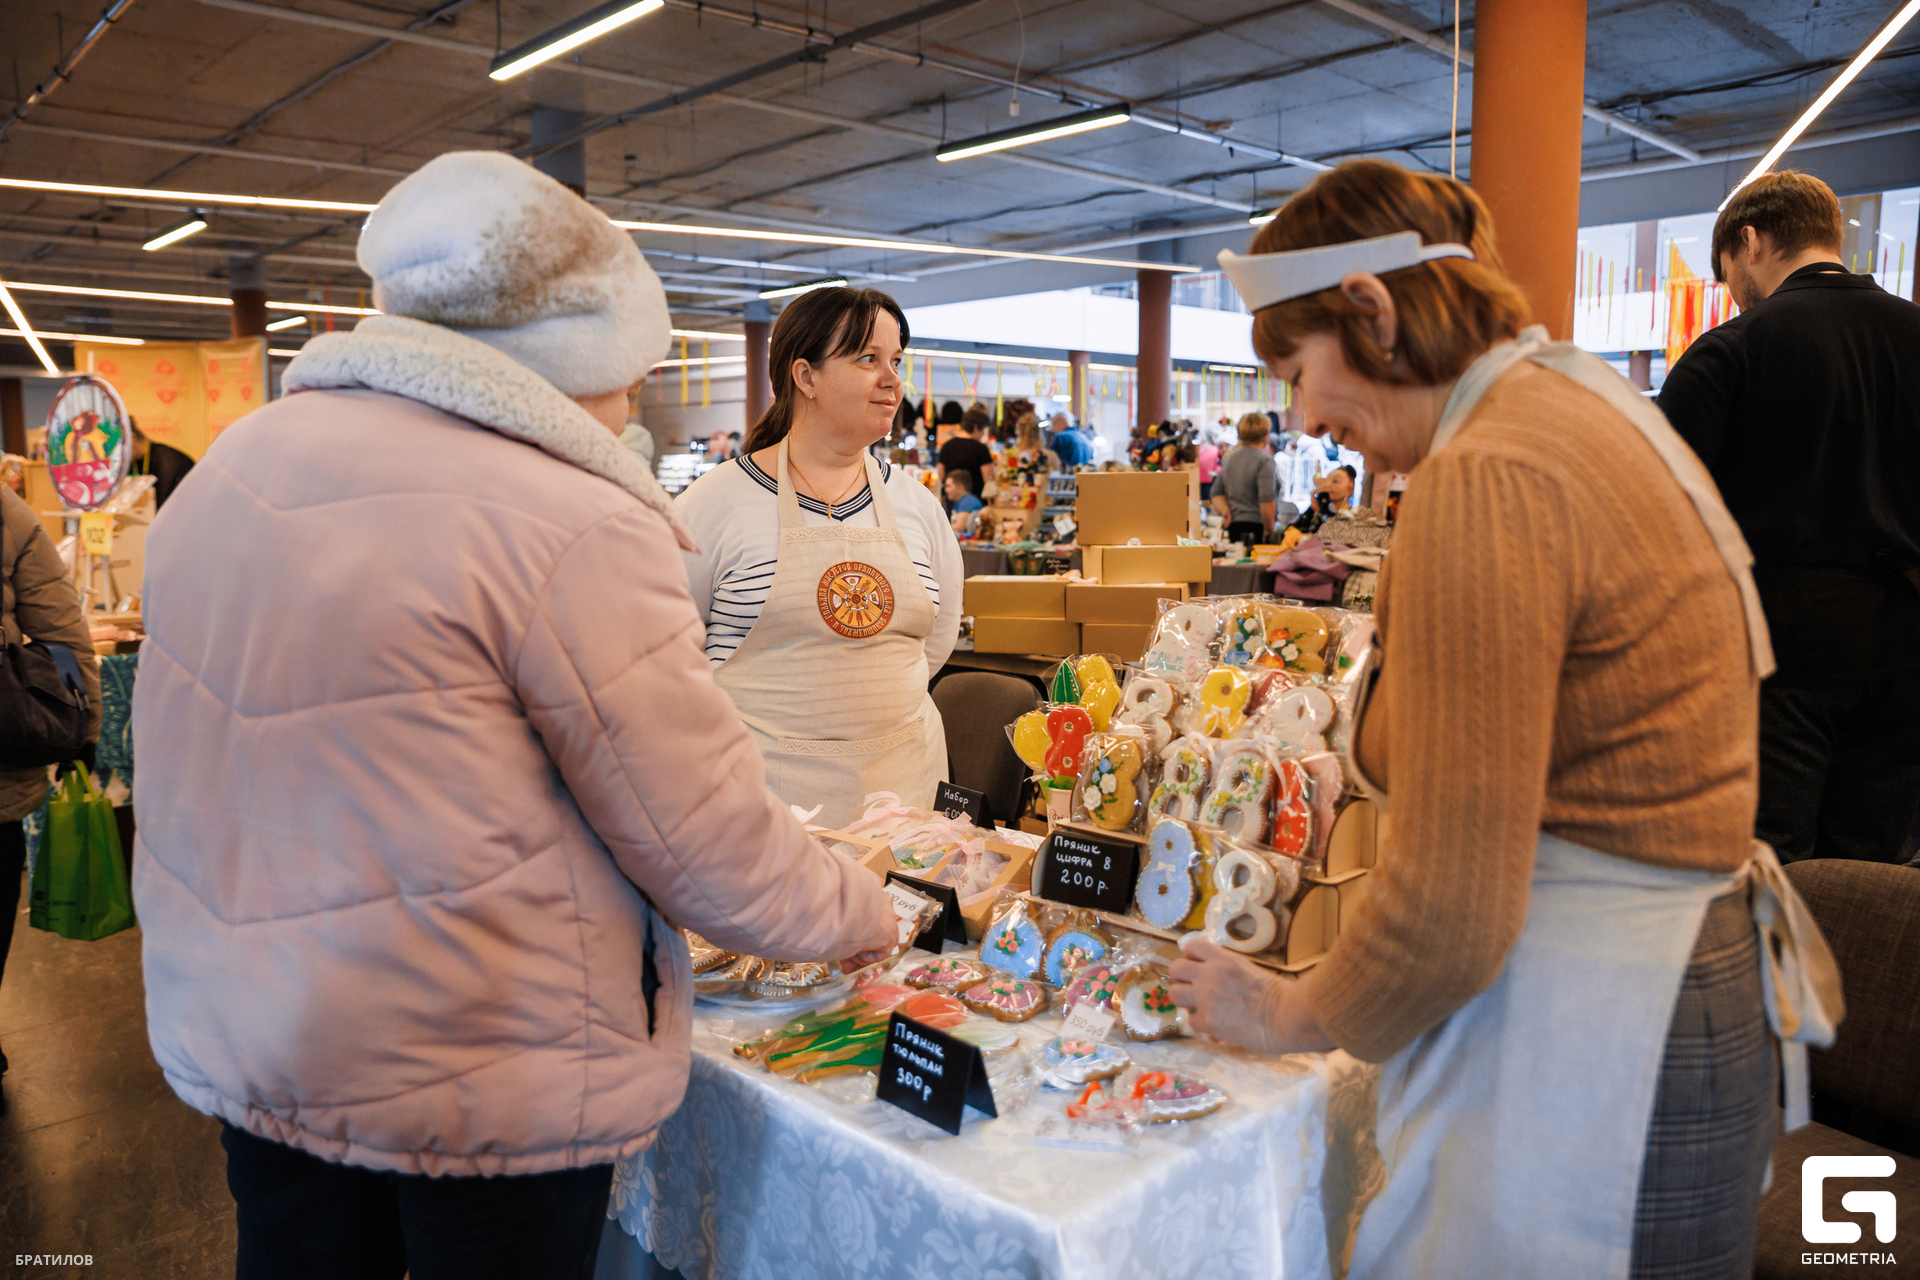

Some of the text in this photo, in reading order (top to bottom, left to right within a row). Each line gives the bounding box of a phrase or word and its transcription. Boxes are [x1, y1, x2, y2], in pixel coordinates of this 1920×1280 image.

[944, 788, 969, 809] Набор
[1103, 856, 1112, 870] 8
[897, 899, 918, 911] руб
[1070, 1014, 1106, 1037] 350 руб
